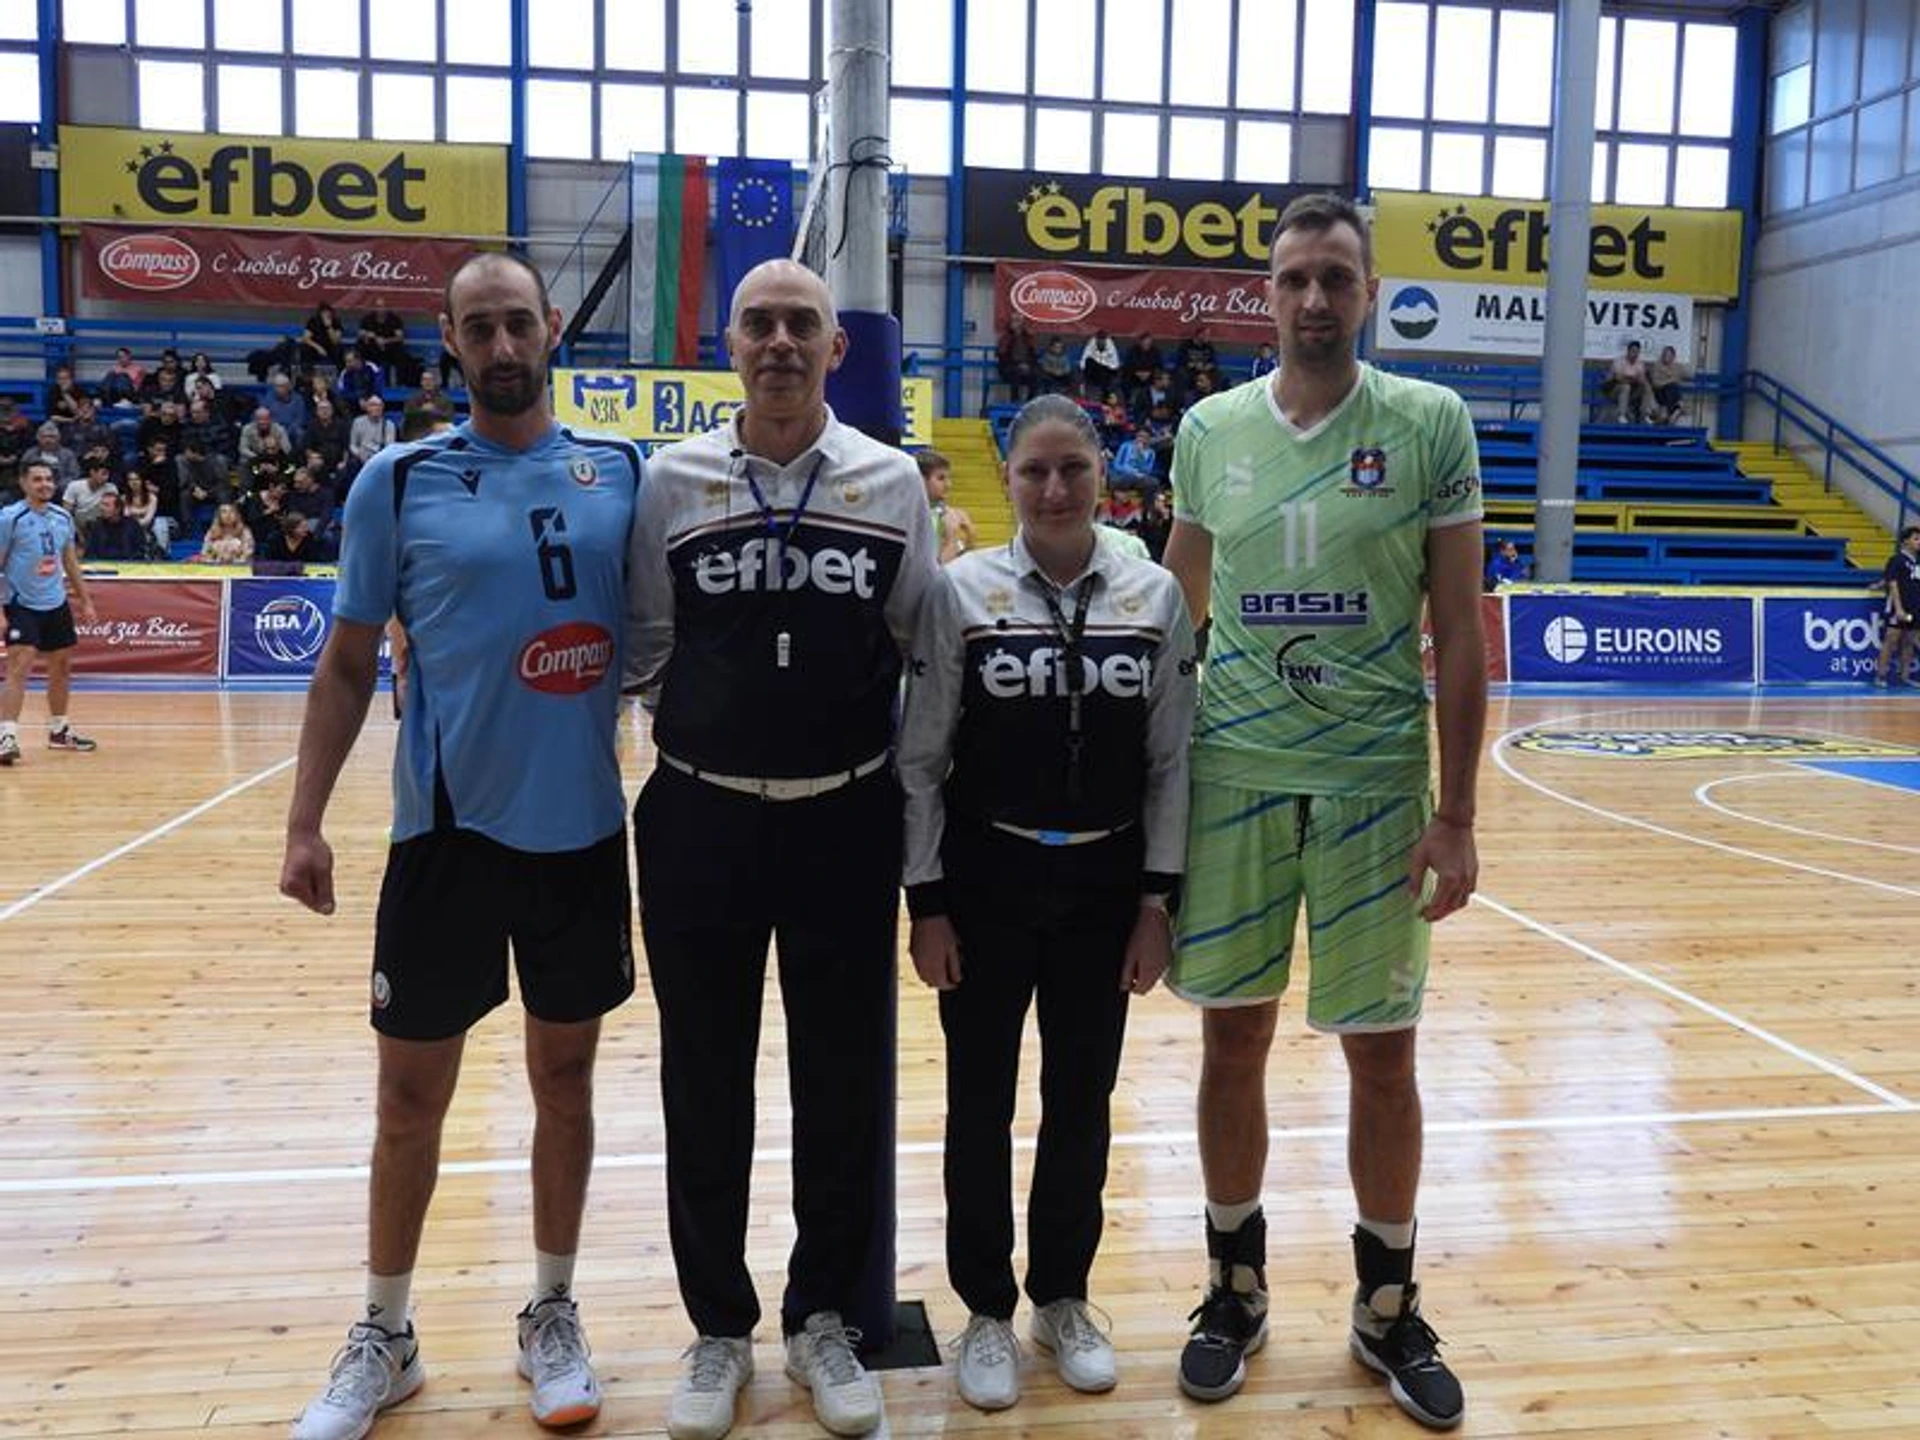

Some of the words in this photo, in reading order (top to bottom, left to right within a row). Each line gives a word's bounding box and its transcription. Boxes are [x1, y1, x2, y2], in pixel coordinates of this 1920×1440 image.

[136, 145, 427, 223] efbet
[1026, 186, 1279, 260] efbet
[107, 245, 191, 273] Compass
[233, 249, 303, 276] любов
[298, 251, 342, 288] за
[1017, 280, 1090, 314] Compass
[1124, 287, 1183, 311] любов
[1181, 292, 1217, 324] за
[1475, 293, 1680, 331] MALVITSA
[1278, 499, 1318, 569] 11
[529, 505, 577, 602] 6
[697, 537, 877, 600] efbet
[1241, 592, 1368, 614] BASK
[107, 621, 140, 645] за
[1595, 627, 1722, 654] EUROINS
[1804, 610, 1882, 652] brot
[1831, 656, 1848, 673] at
